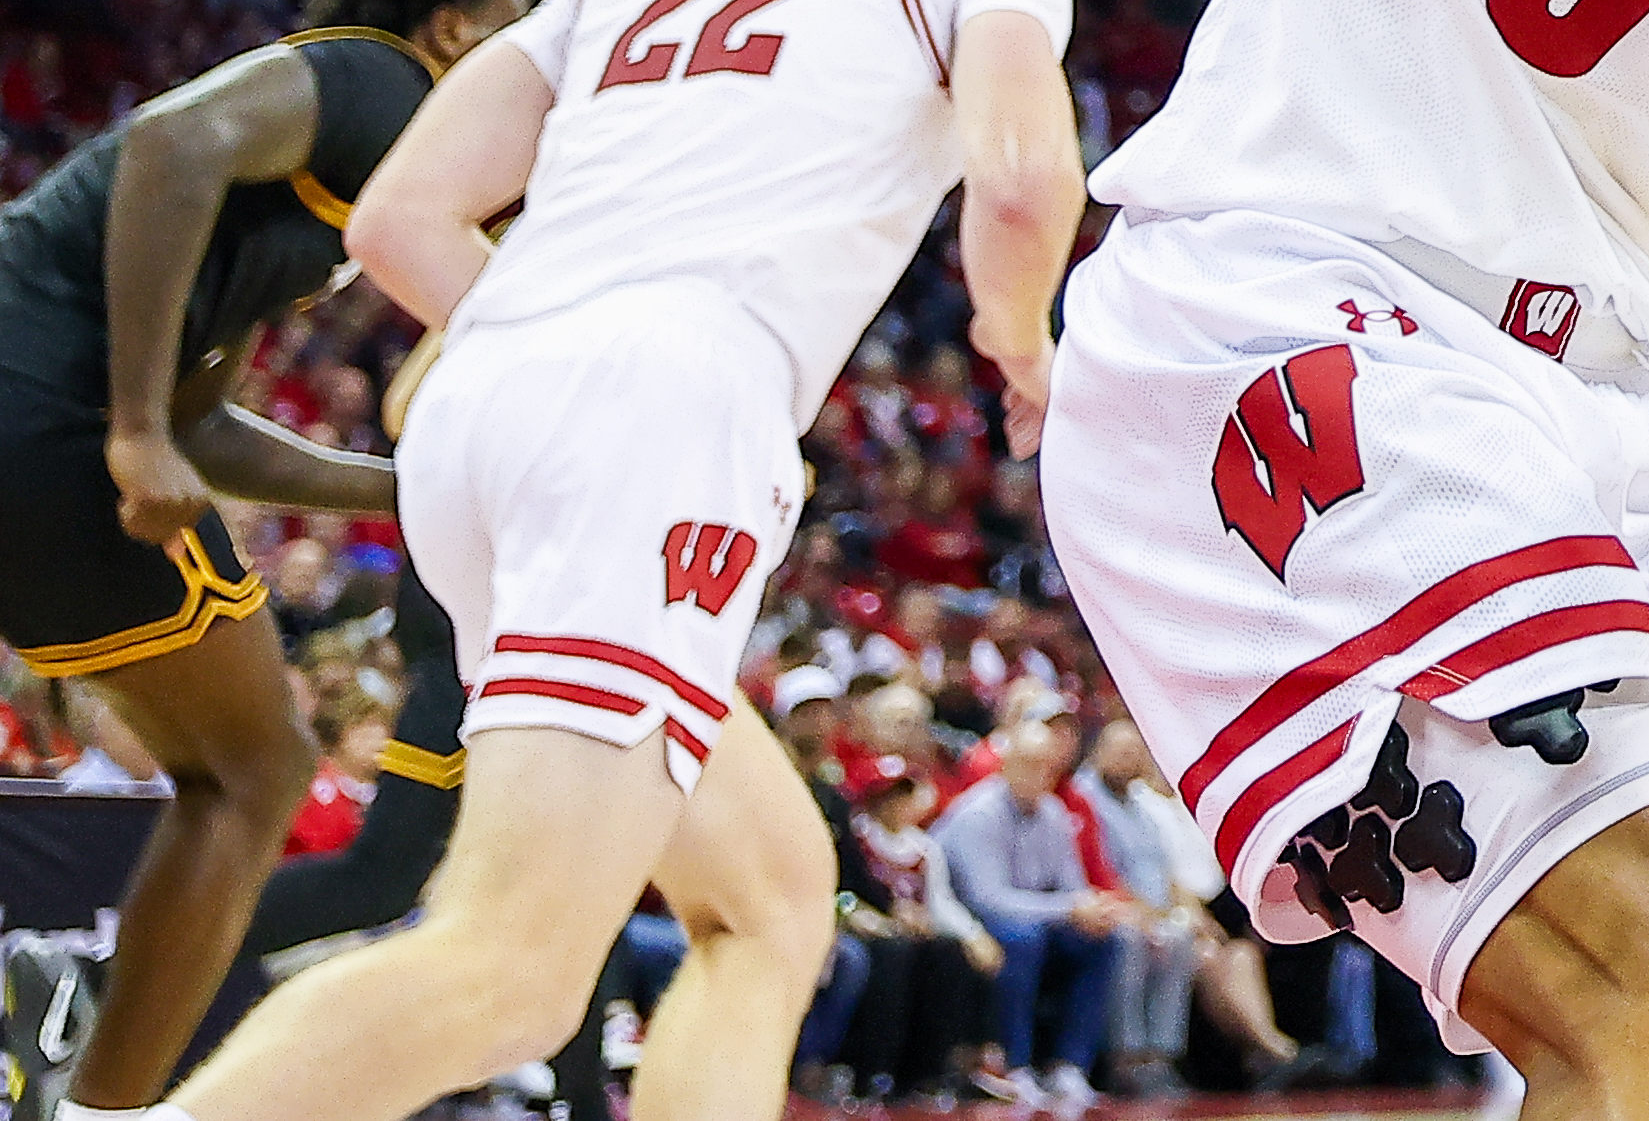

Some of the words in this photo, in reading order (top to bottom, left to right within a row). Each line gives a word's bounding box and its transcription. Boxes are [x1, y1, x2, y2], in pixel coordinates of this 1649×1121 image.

[1525, 290, 1575, 338] W
[1212, 343, 1366, 583] W
[660, 520, 757, 617] W
